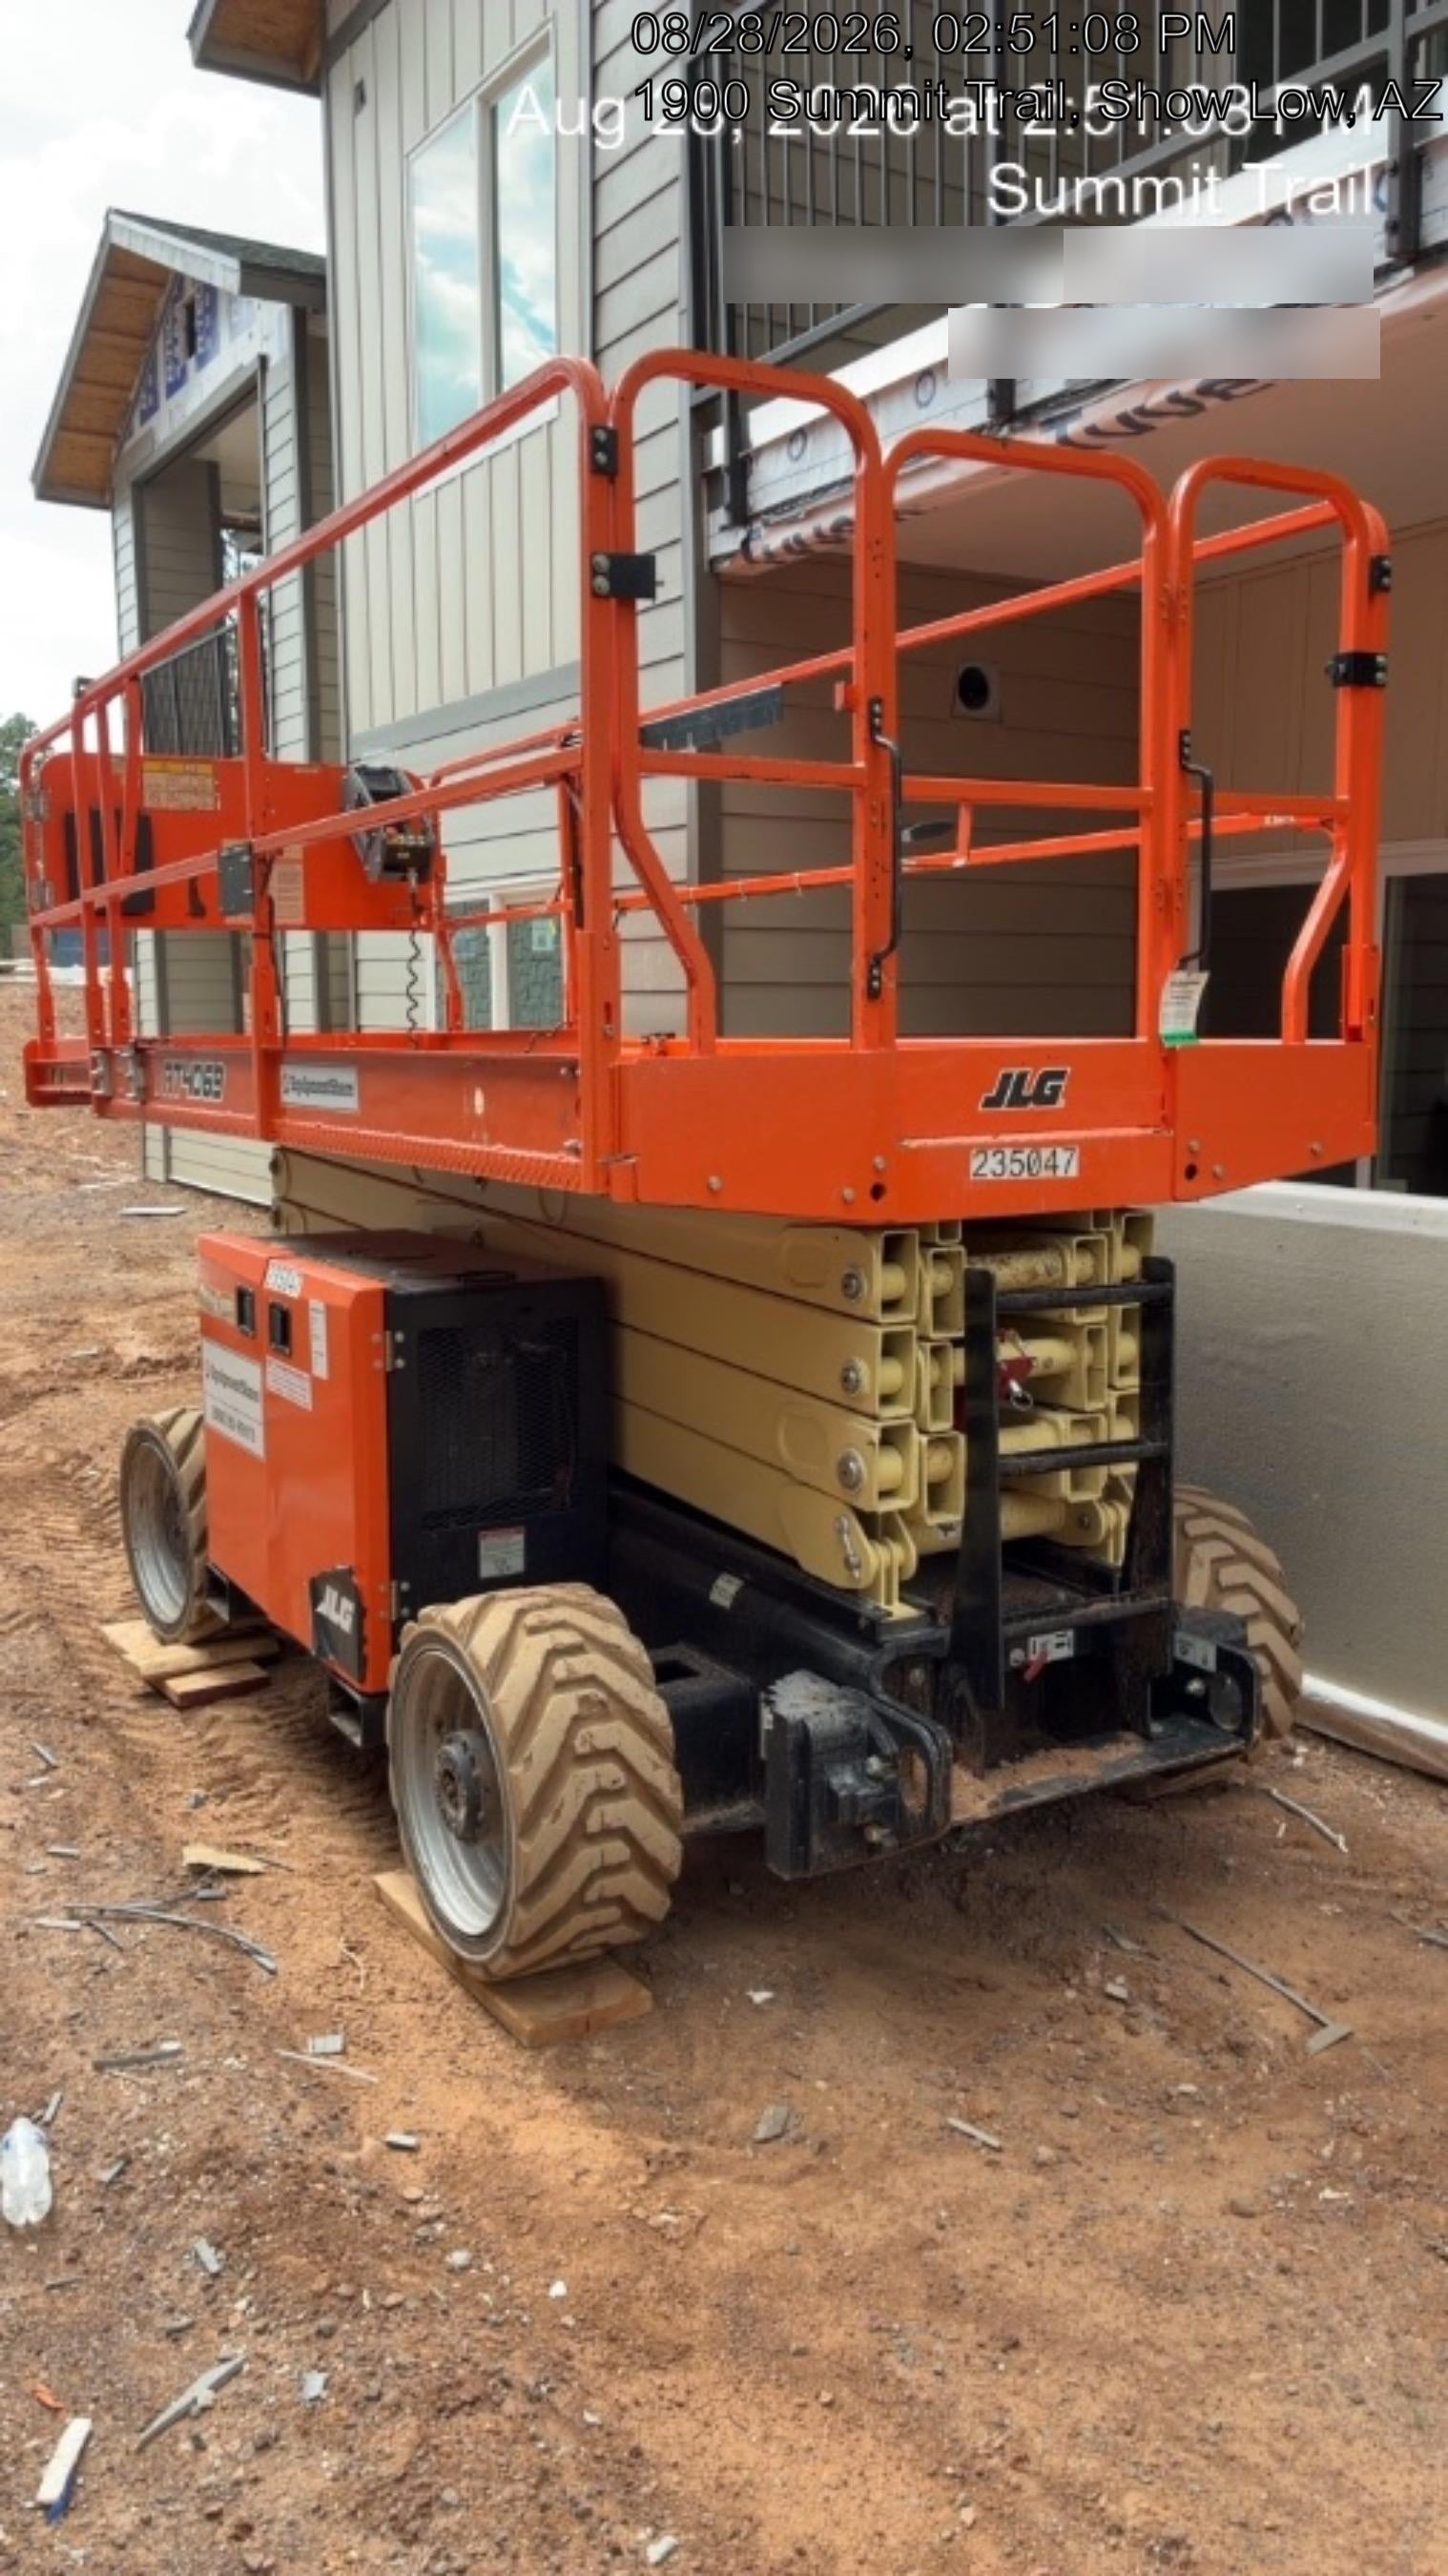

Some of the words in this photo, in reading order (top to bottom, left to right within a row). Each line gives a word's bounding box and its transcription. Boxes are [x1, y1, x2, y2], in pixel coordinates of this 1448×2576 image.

[980, 1068, 1069, 1110] JLG
[972, 1148, 1077, 1177] 235047
[316, 1584, 356, 1633] JLG
